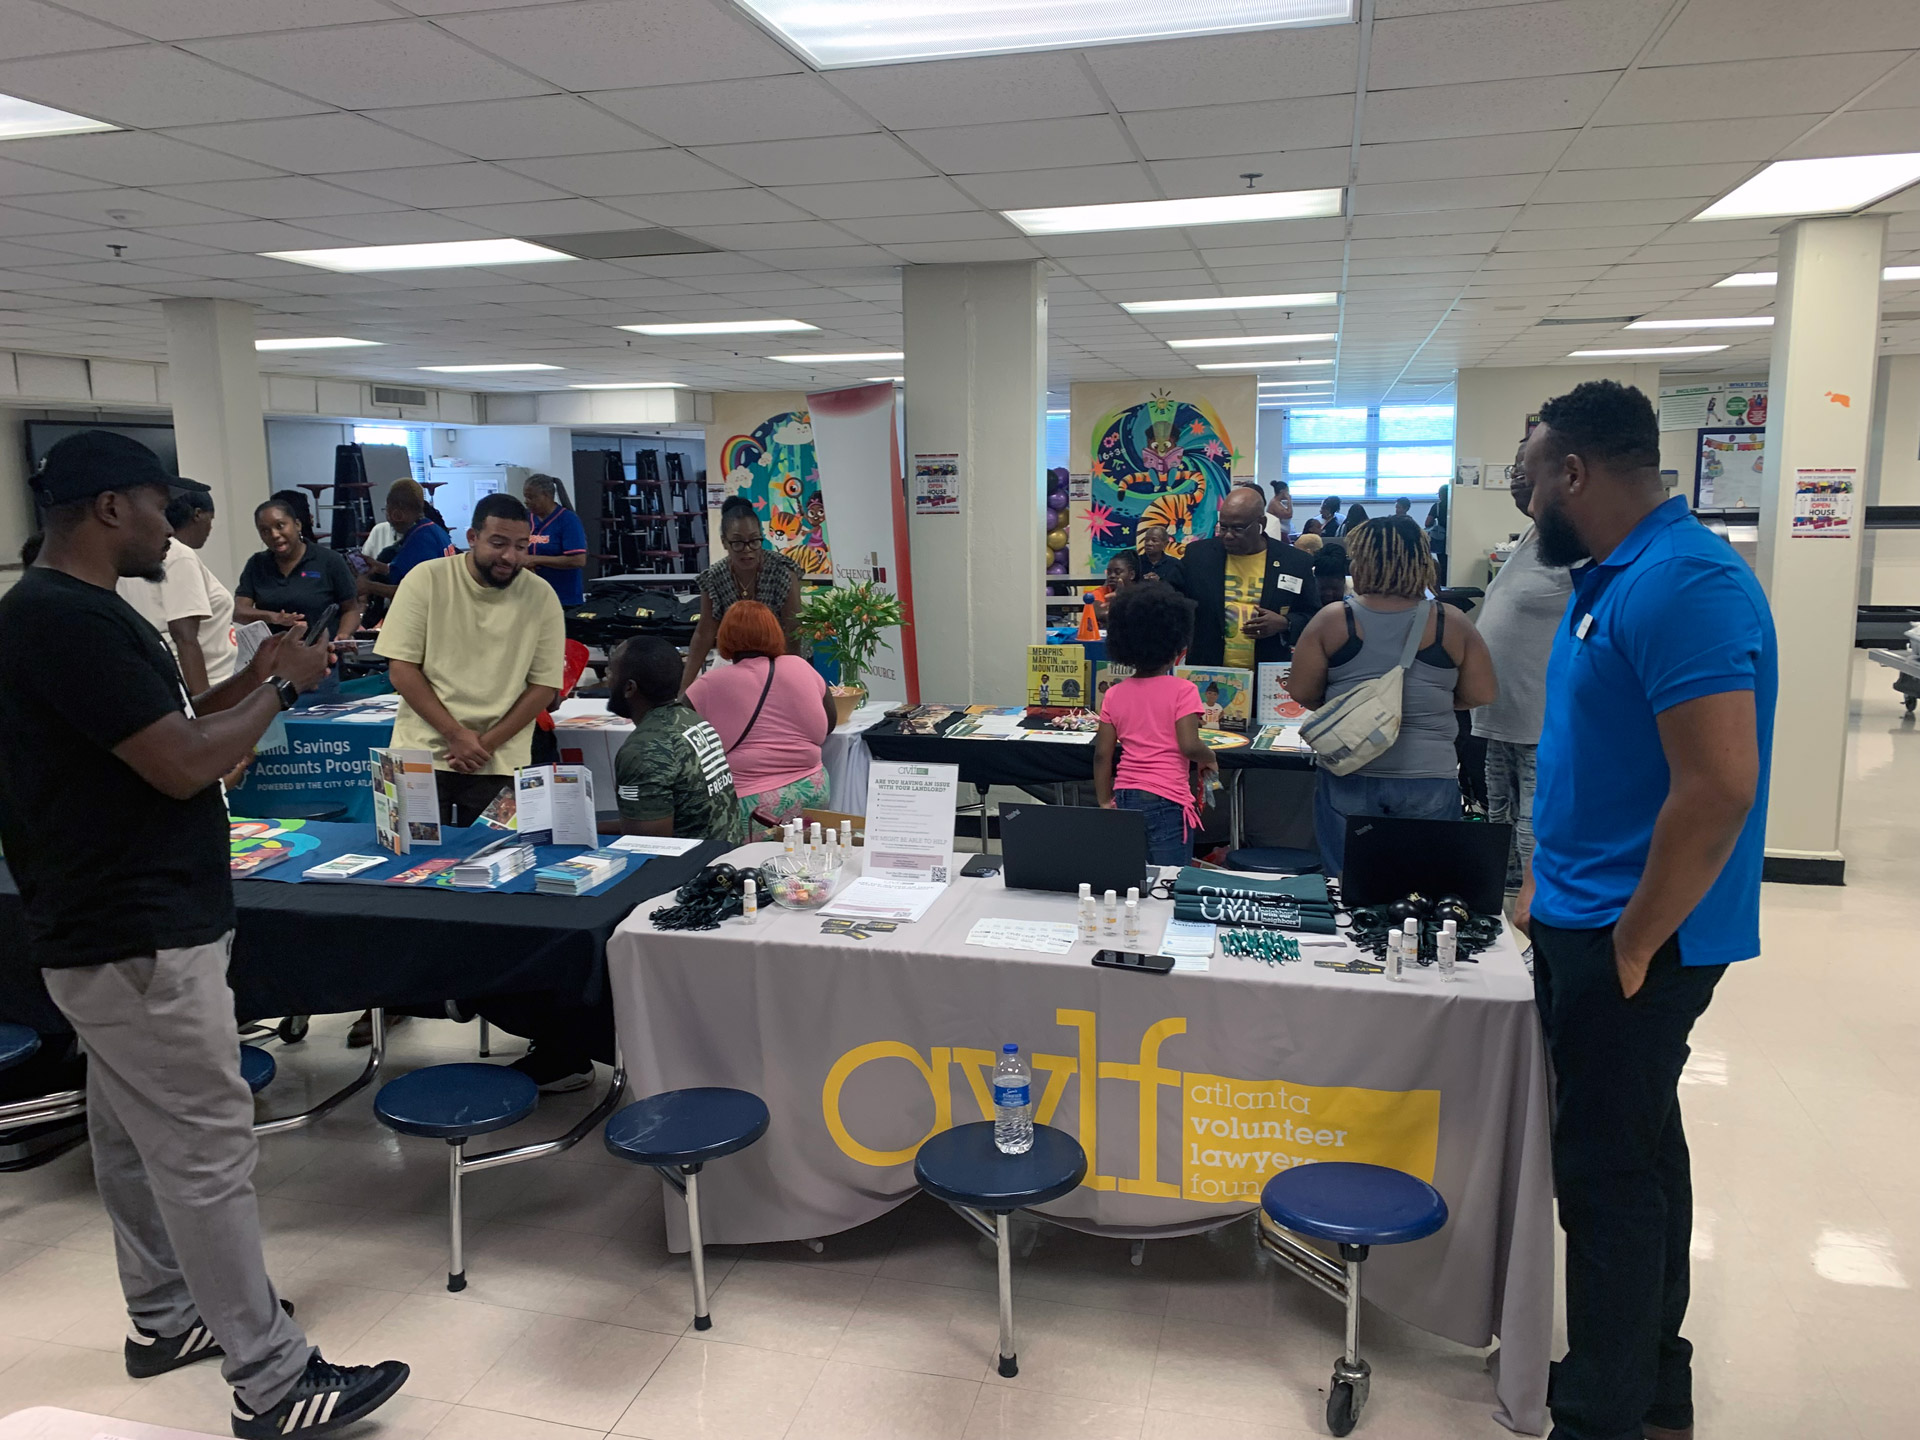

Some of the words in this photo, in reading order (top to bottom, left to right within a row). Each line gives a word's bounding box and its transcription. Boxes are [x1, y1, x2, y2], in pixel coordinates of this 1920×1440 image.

[1032, 664, 1079, 674] MOUNTAINTOP
[293, 739, 351, 755] Savings
[255, 761, 321, 776] Accounts
[257, 783, 294, 791] POWERED
[295, 782, 306, 790] BY
[324, 780, 342, 789] CITY
[1190, 1082, 1311, 1115] atlanta
[1190, 1116, 1348, 1147] volunteer
